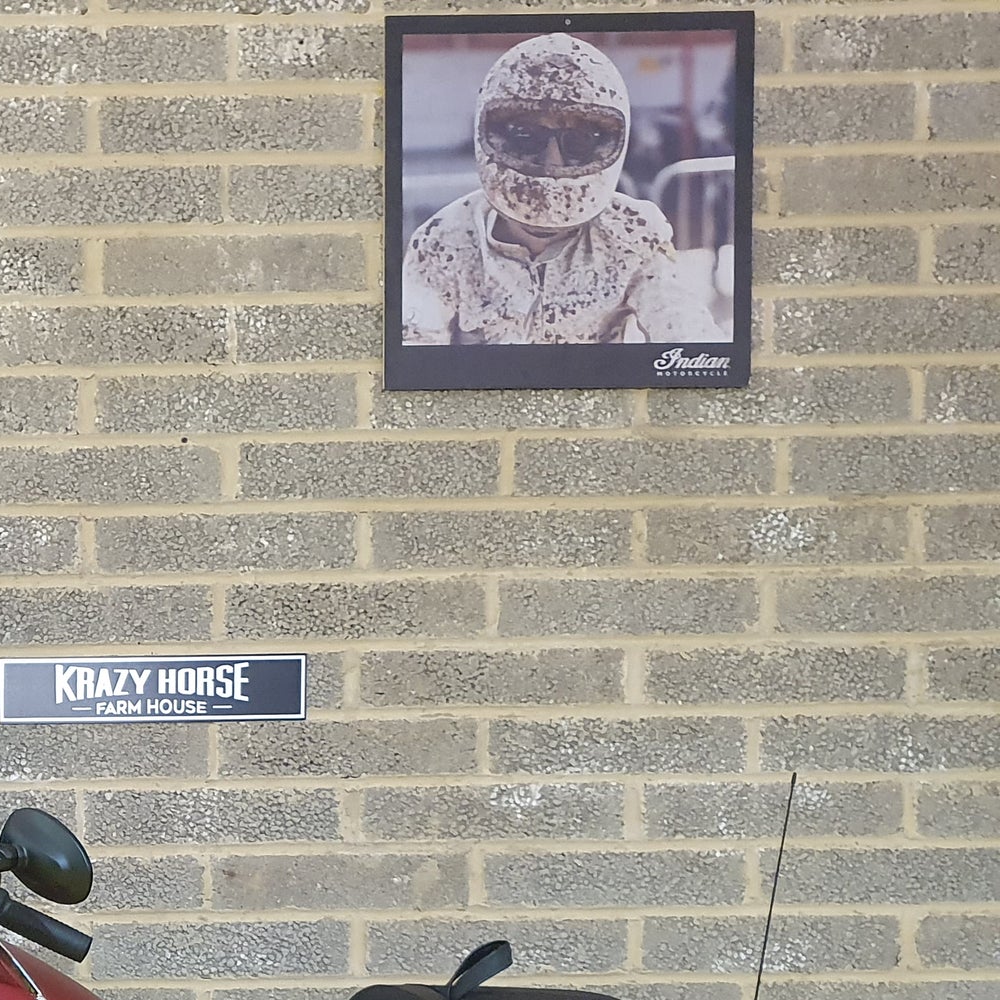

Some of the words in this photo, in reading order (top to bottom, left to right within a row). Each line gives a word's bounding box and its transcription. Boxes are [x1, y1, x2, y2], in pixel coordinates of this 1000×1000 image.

[653, 347, 731, 370] Indian
[54, 663, 151, 705] KRAZY
[157, 661, 249, 702] HORSE
[96, 701, 142, 715] FARM
[146, 698, 208, 714] HOUSE
